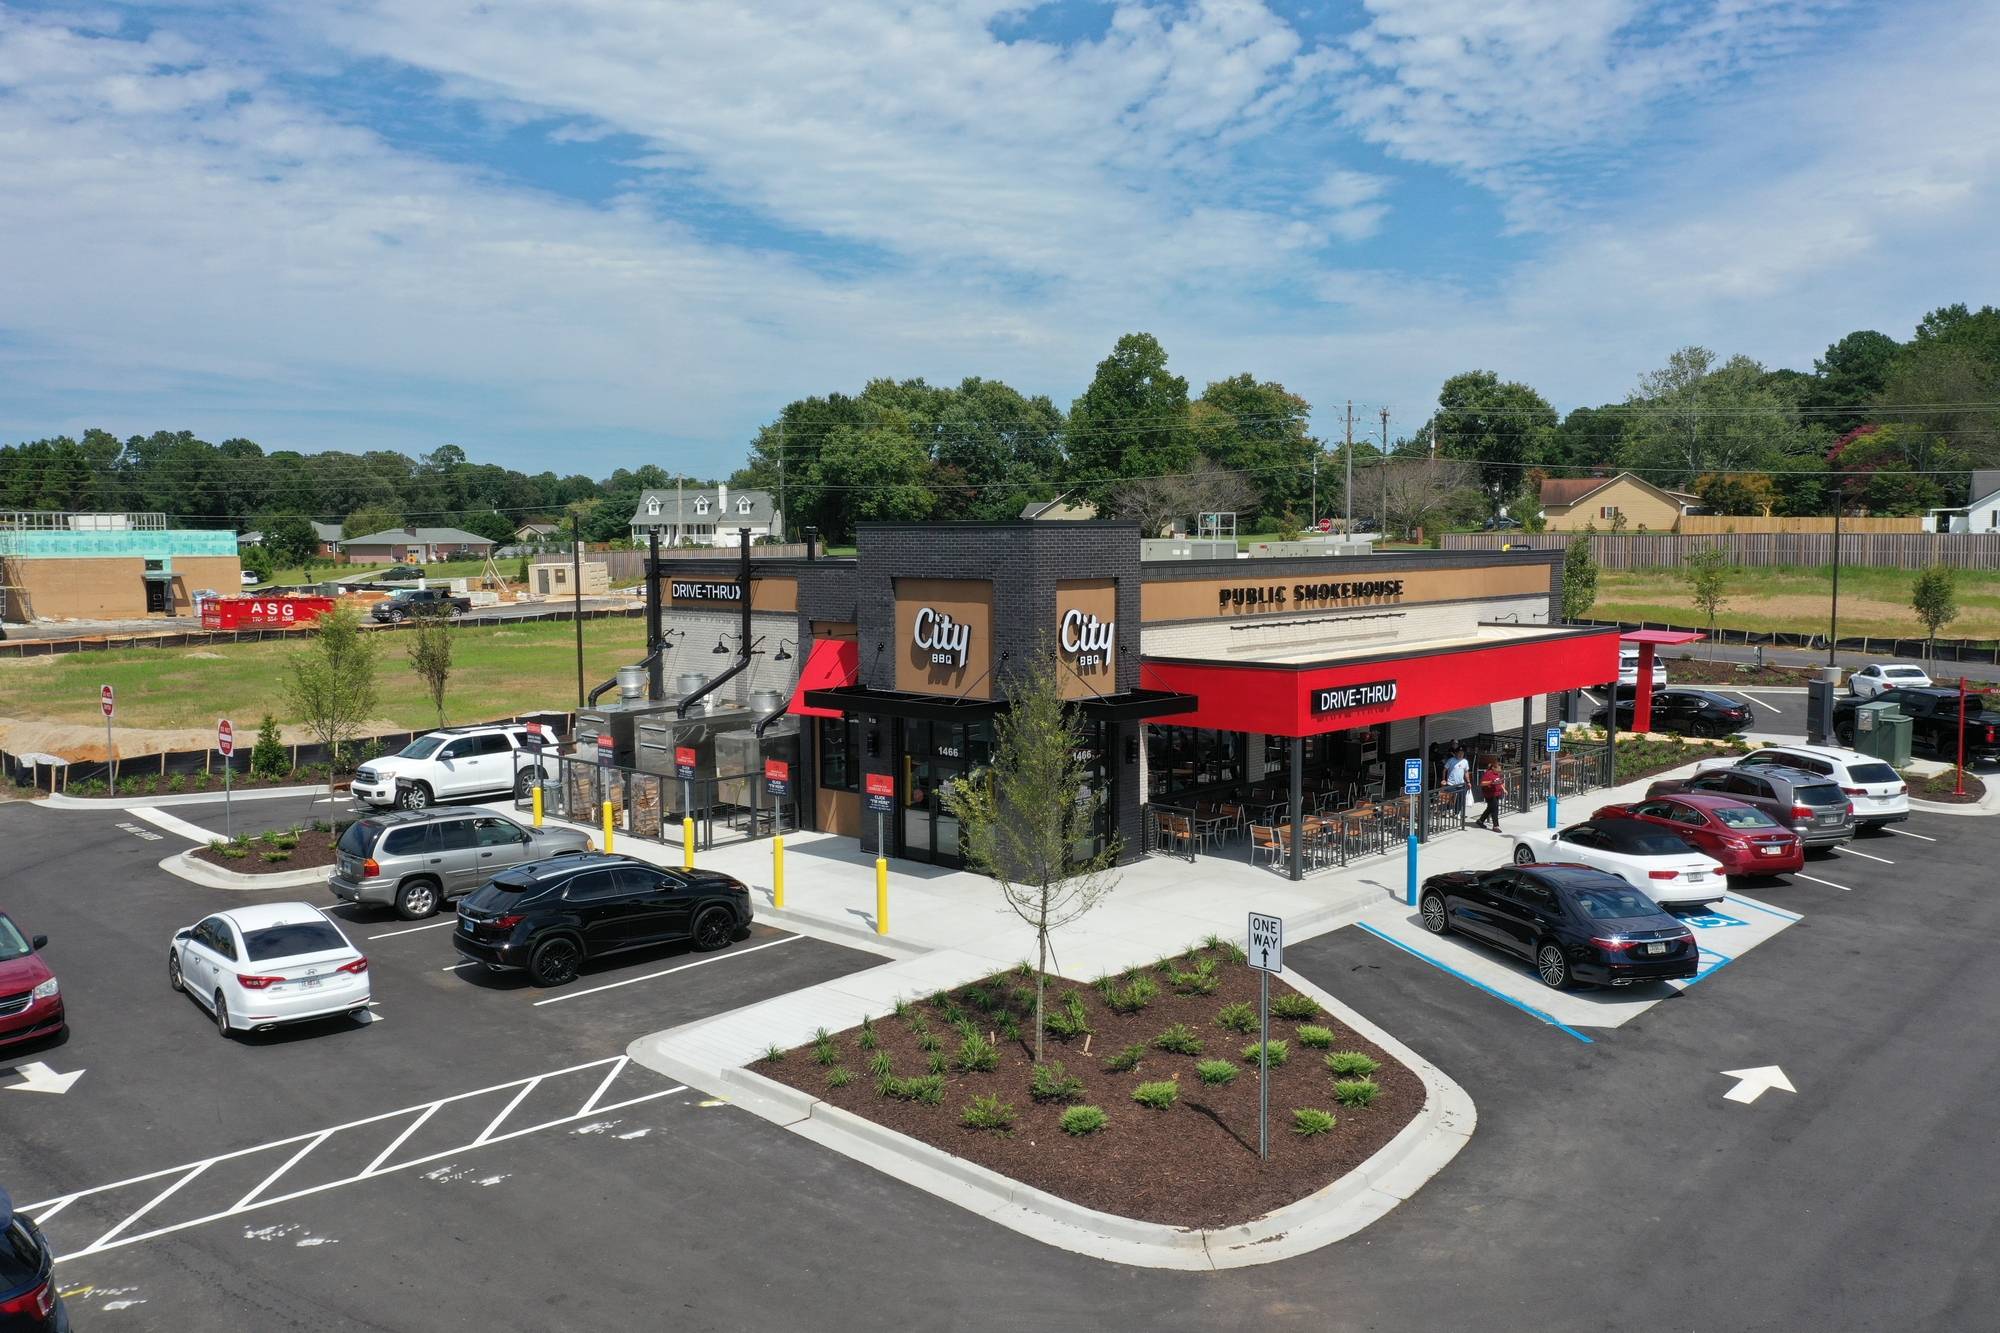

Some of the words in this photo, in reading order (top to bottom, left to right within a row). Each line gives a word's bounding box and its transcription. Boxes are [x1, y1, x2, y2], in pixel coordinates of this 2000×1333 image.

[672, 583, 735, 599] DRIVE-THRU
[1219, 586, 1286, 606] PUBLIC
[1293, 580, 1404, 601] SMOKEHOUSE
[914, 607, 970, 668] City
[1061, 609, 1114, 667] City
[931, 653, 953, 665] BBQ
[1080, 654, 1100, 666] BBQ
[1321, 684, 1391, 711] DRIVE-THRU
[938, 746, 958, 757] 1466
[1073, 750, 1092, 761] 1466
[1253, 917, 1277, 934] ONE
[1254, 932, 1278, 949] WAY
